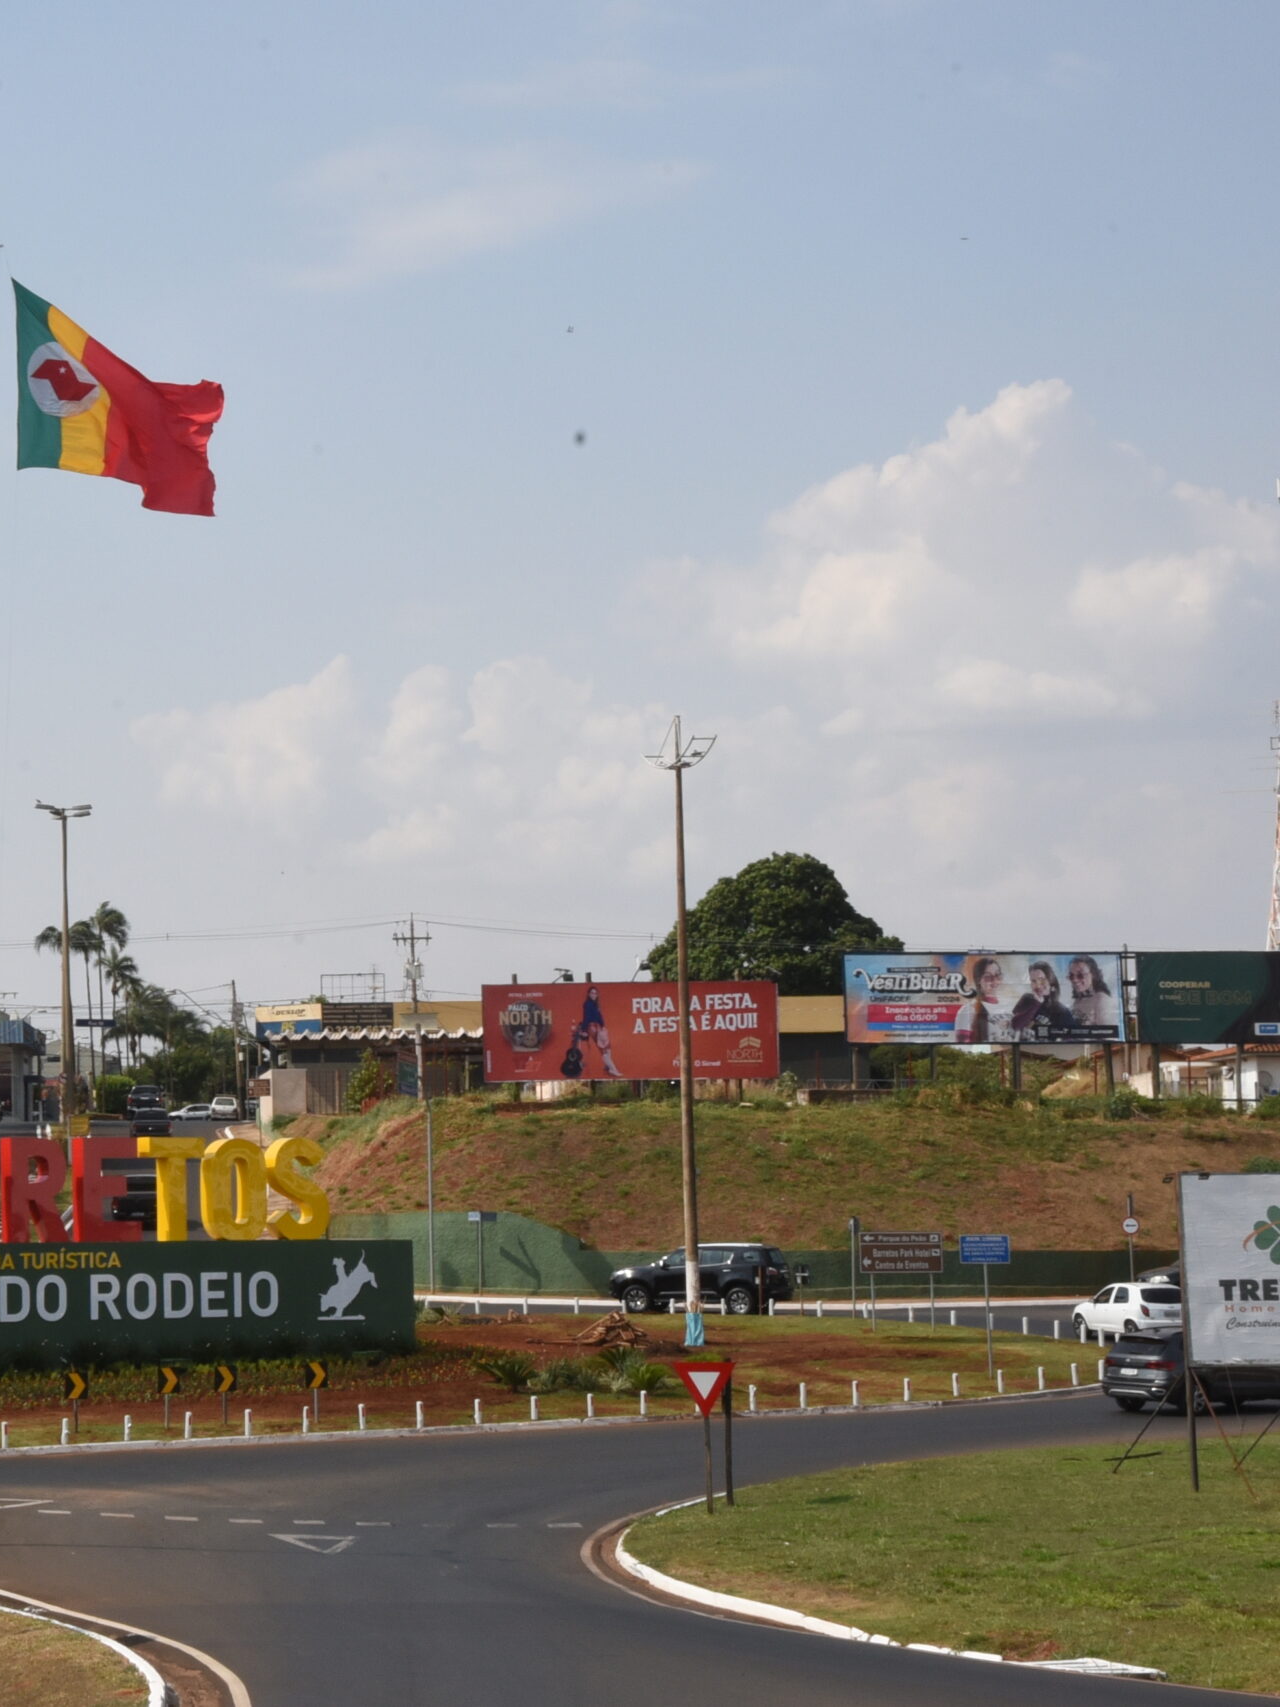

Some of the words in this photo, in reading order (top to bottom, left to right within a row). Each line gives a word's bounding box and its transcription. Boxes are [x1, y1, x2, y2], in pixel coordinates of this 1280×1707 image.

[1158, 981, 1211, 989] COOPERAR
[508, 1004, 528, 1012] PALCO
[632, 996, 676, 1014] FORA
[705, 993, 758, 1011] FESTA.
[499, 1010, 552, 1026] NORTH
[633, 1018, 646, 1034] A
[649, 1016, 698, 1033] FESA
[701, 1011, 711, 1031] É
[713, 1013, 758, 1032] AQUI!
[726, 1048, 763, 1060] NORTH
[20, 1248, 122, 1270] TURÍSTICA
[872, 1248, 899, 1257] Barretos
[900, 1248, 914, 1257] Park
[0, 1274, 68, 1323] DO
[90, 1271, 279, 1321] RODEIO
[1225, 1304, 1276, 1312] Home
